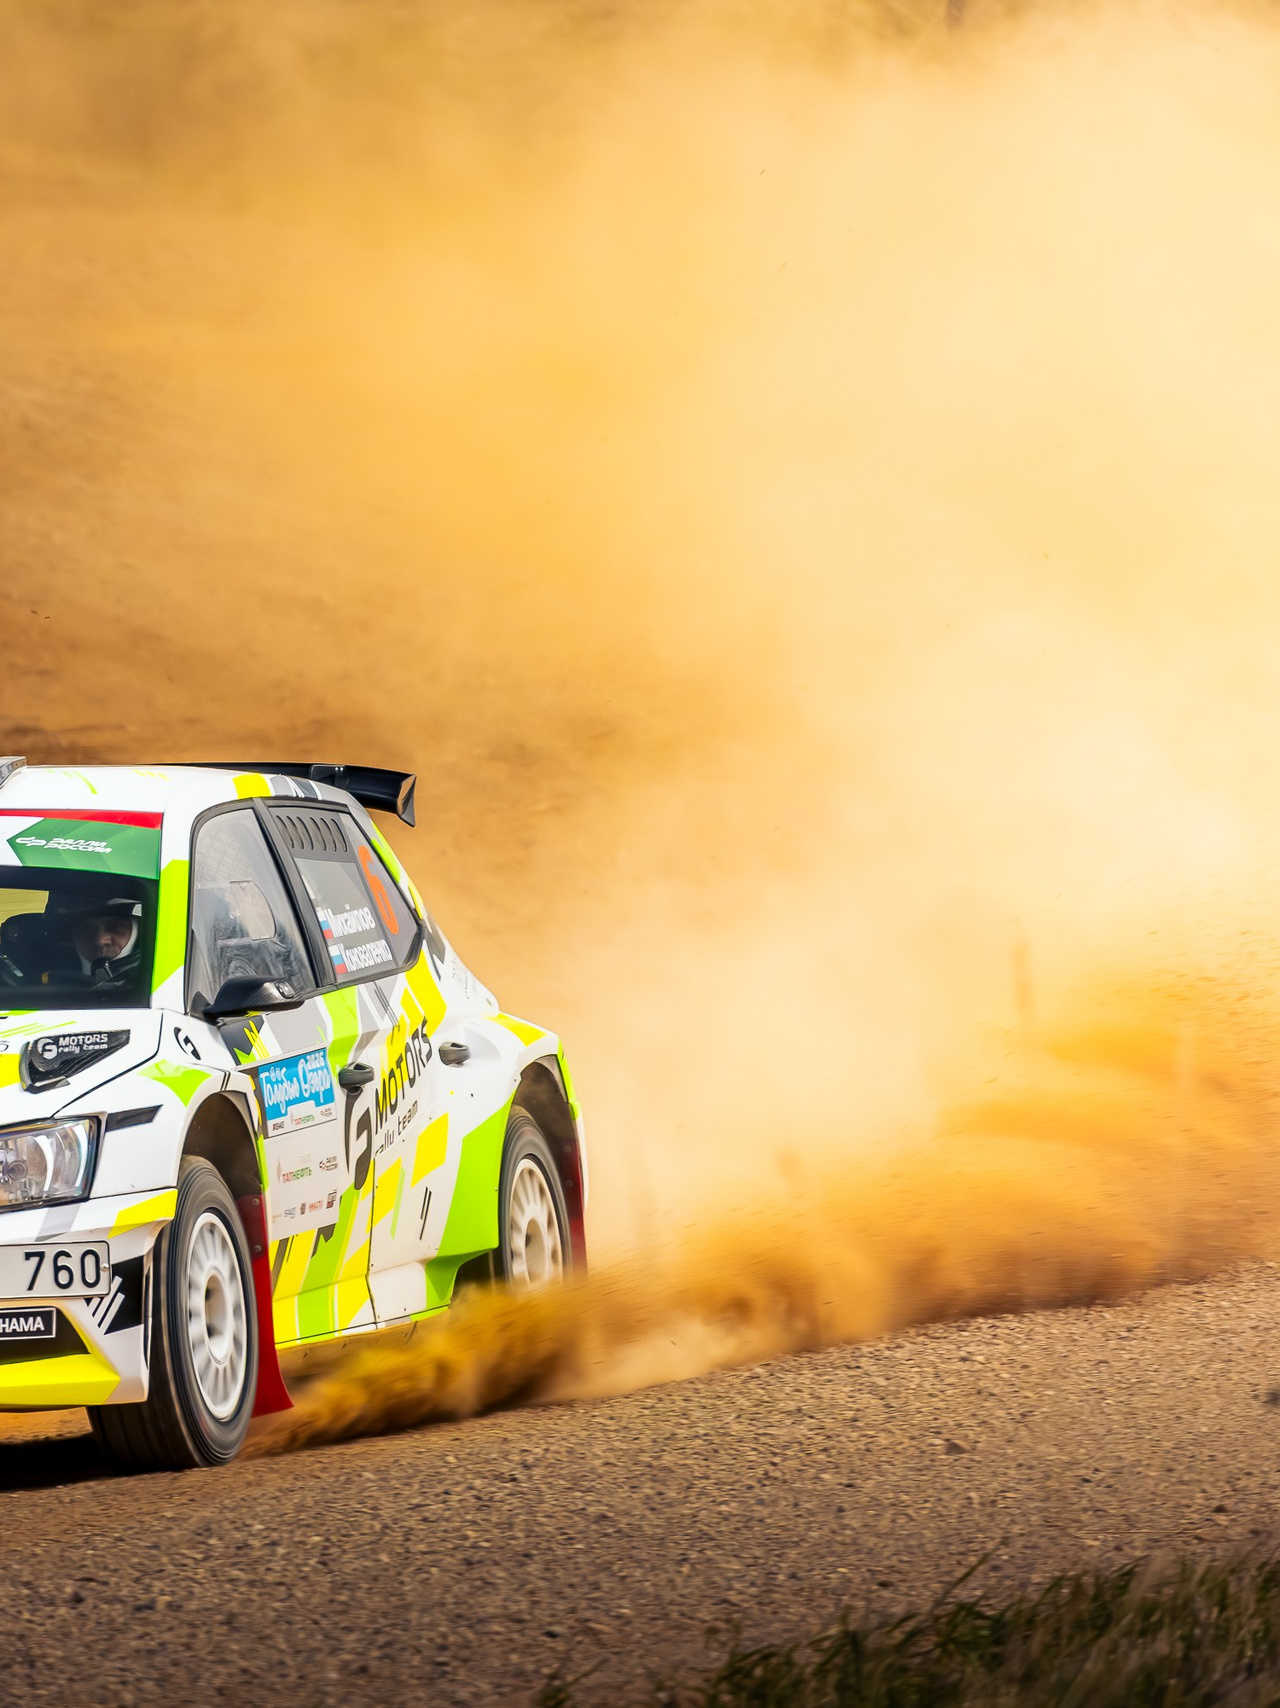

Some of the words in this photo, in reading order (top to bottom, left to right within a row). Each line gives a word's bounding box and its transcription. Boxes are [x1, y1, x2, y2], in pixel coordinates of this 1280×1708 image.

[357, 845, 399, 935] 6
[59, 1034, 108, 1046] MOTORS
[375, 1016, 433, 1135] MOTORS
[397, 1100, 418, 1136] team
[24, 1248, 102, 1291] 760
